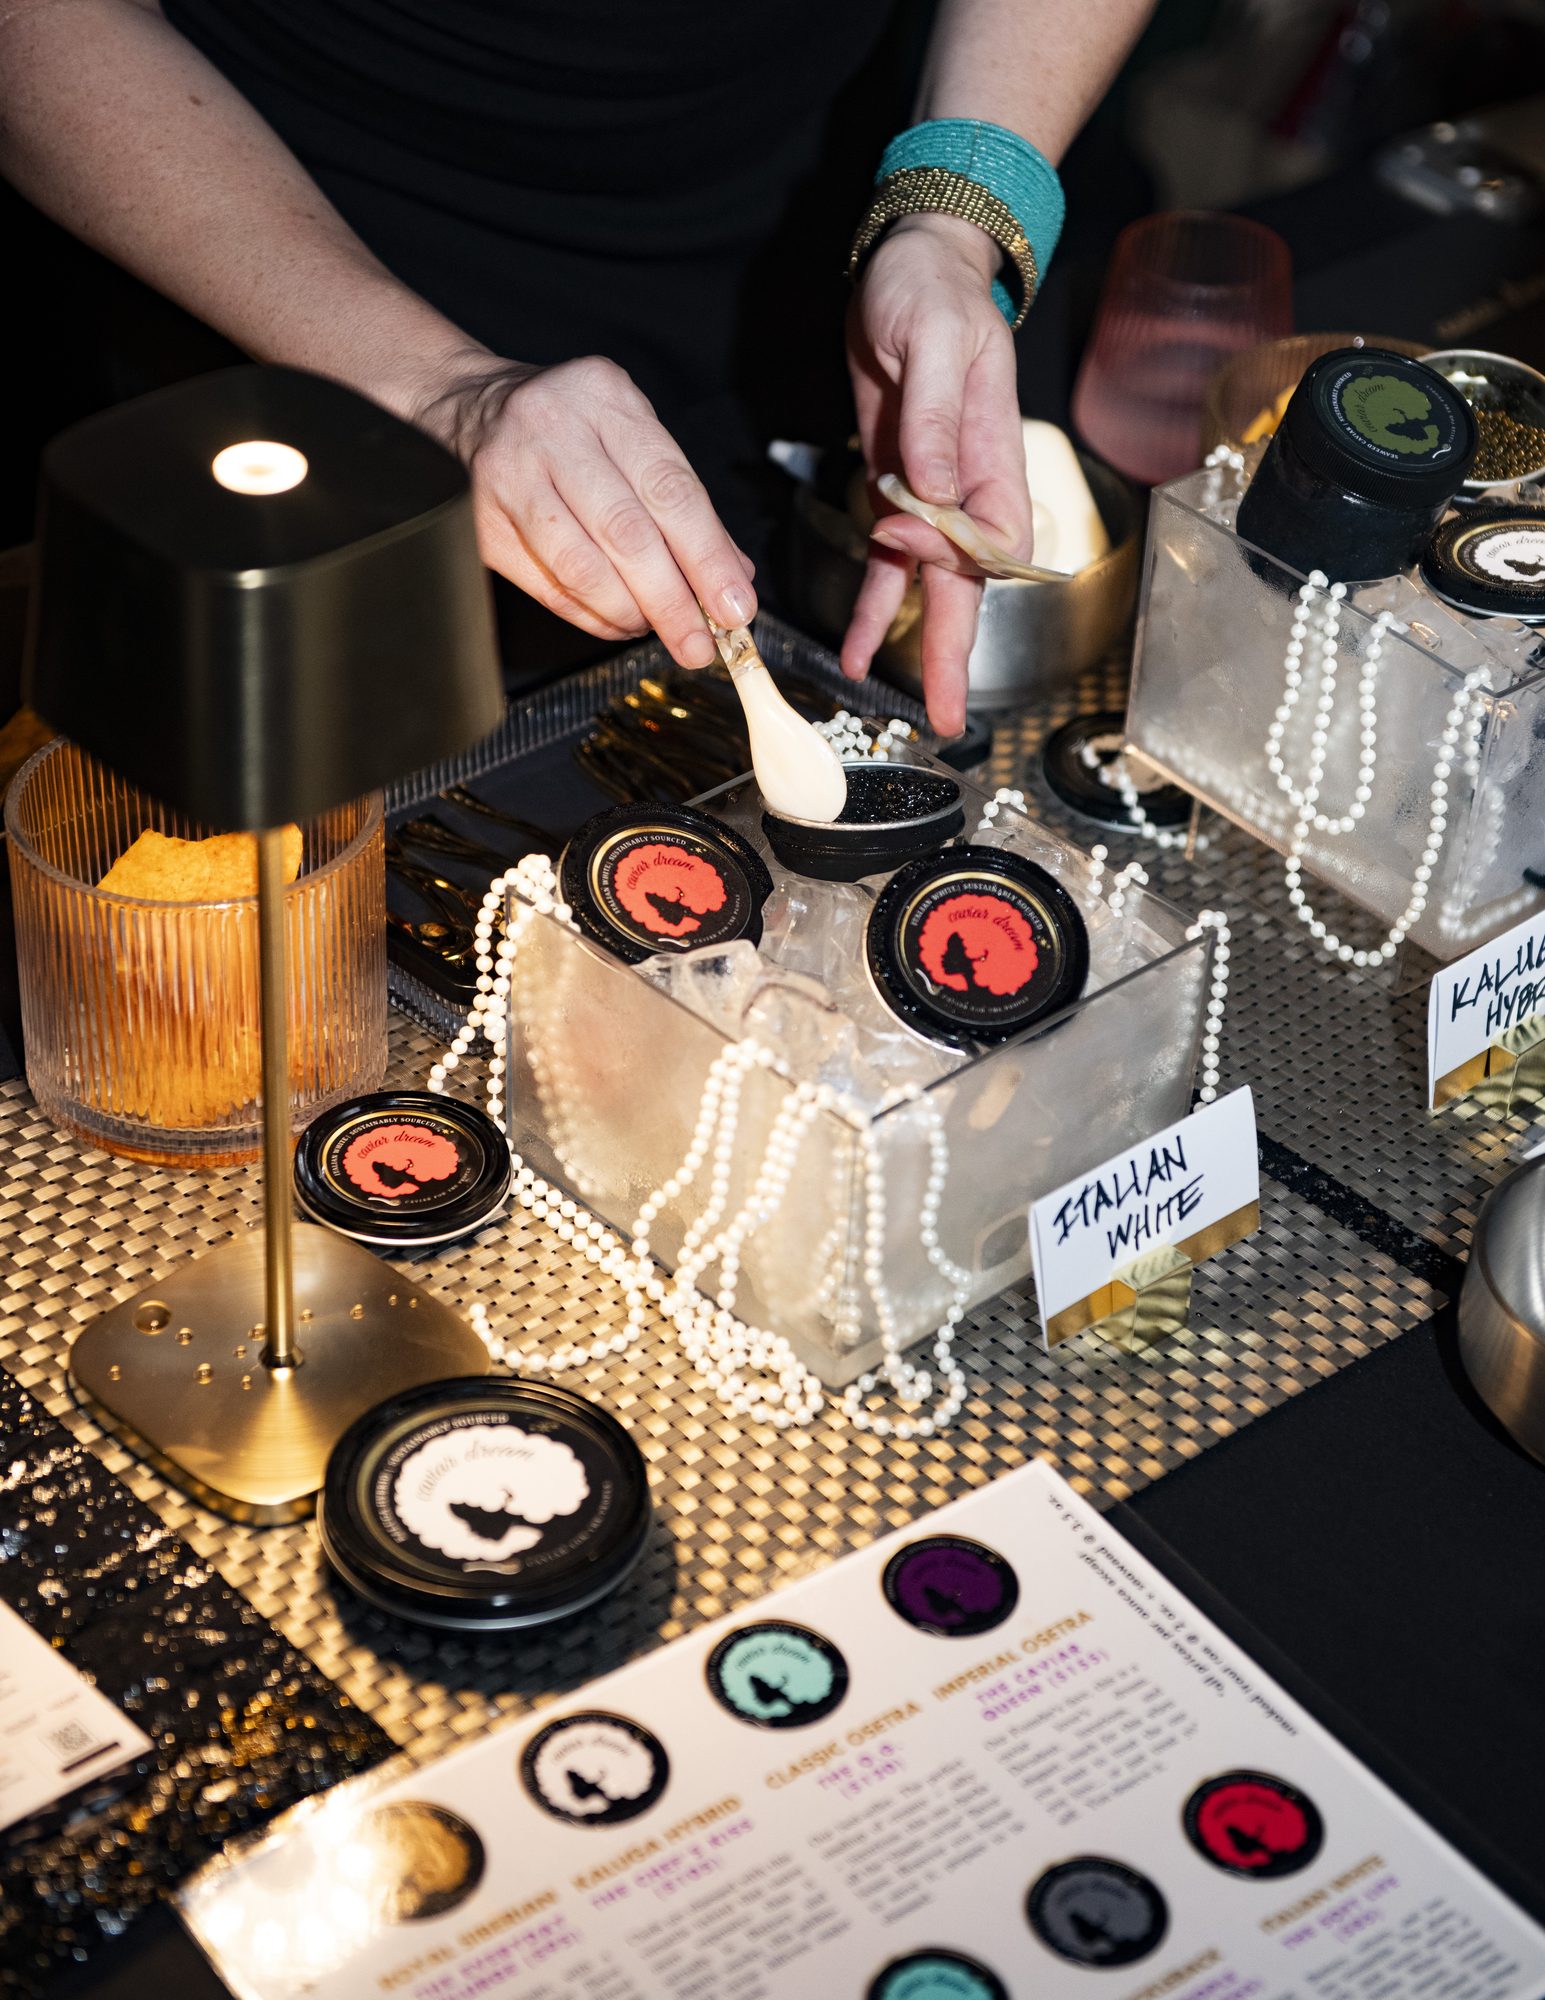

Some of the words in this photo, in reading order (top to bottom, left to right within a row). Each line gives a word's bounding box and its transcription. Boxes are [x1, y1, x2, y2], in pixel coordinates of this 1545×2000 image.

[1346, 426, 1367, 445] CAVIAR
[1366, 442, 1399, 460] SEAWEED
[608, 835, 649, 862] SUSTAINABLY
[650, 834, 688, 846] SOURCED
[601, 864, 612, 887] WHITE
[653, 851, 696, 872] dream
[602, 887, 621, 916] ITALIAN
[1016, 898, 1044, 931] SOURCED
[350, 1117, 399, 1136] SUSTAINABLY
[399, 1117, 437, 1128] SOURCED
[357, 1135, 390, 1160] caviar
[393, 1130, 438, 1149] dream
[1052, 1134, 1188, 1247] ITALIAN
[1107, 1174, 1205, 1260] WHITE
[387, 1419, 450, 1468] SUSTAINABLY
[450, 1412, 510, 1430] SOURCED
[1077, 1551, 1117, 1588] except
[1096, 1545, 1146, 1591] seaweed
[1116, 1588, 1151, 1621] ounce
[1151, 1621, 1174, 1642] per
[932, 1650, 1022, 1702] IMPERIAL
[1020, 1609, 1095, 1654] OSETRA
[1012, 1641, 1081, 1685] CAVIAR
[1172, 1641, 1209, 1676] prices
[981, 1682, 1043, 1721] QUEEN
[1249, 1693, 1300, 1737] smoked
[764, 1740, 844, 1790] CLASSIC
[845, 1700, 923, 1747] OSETRA
